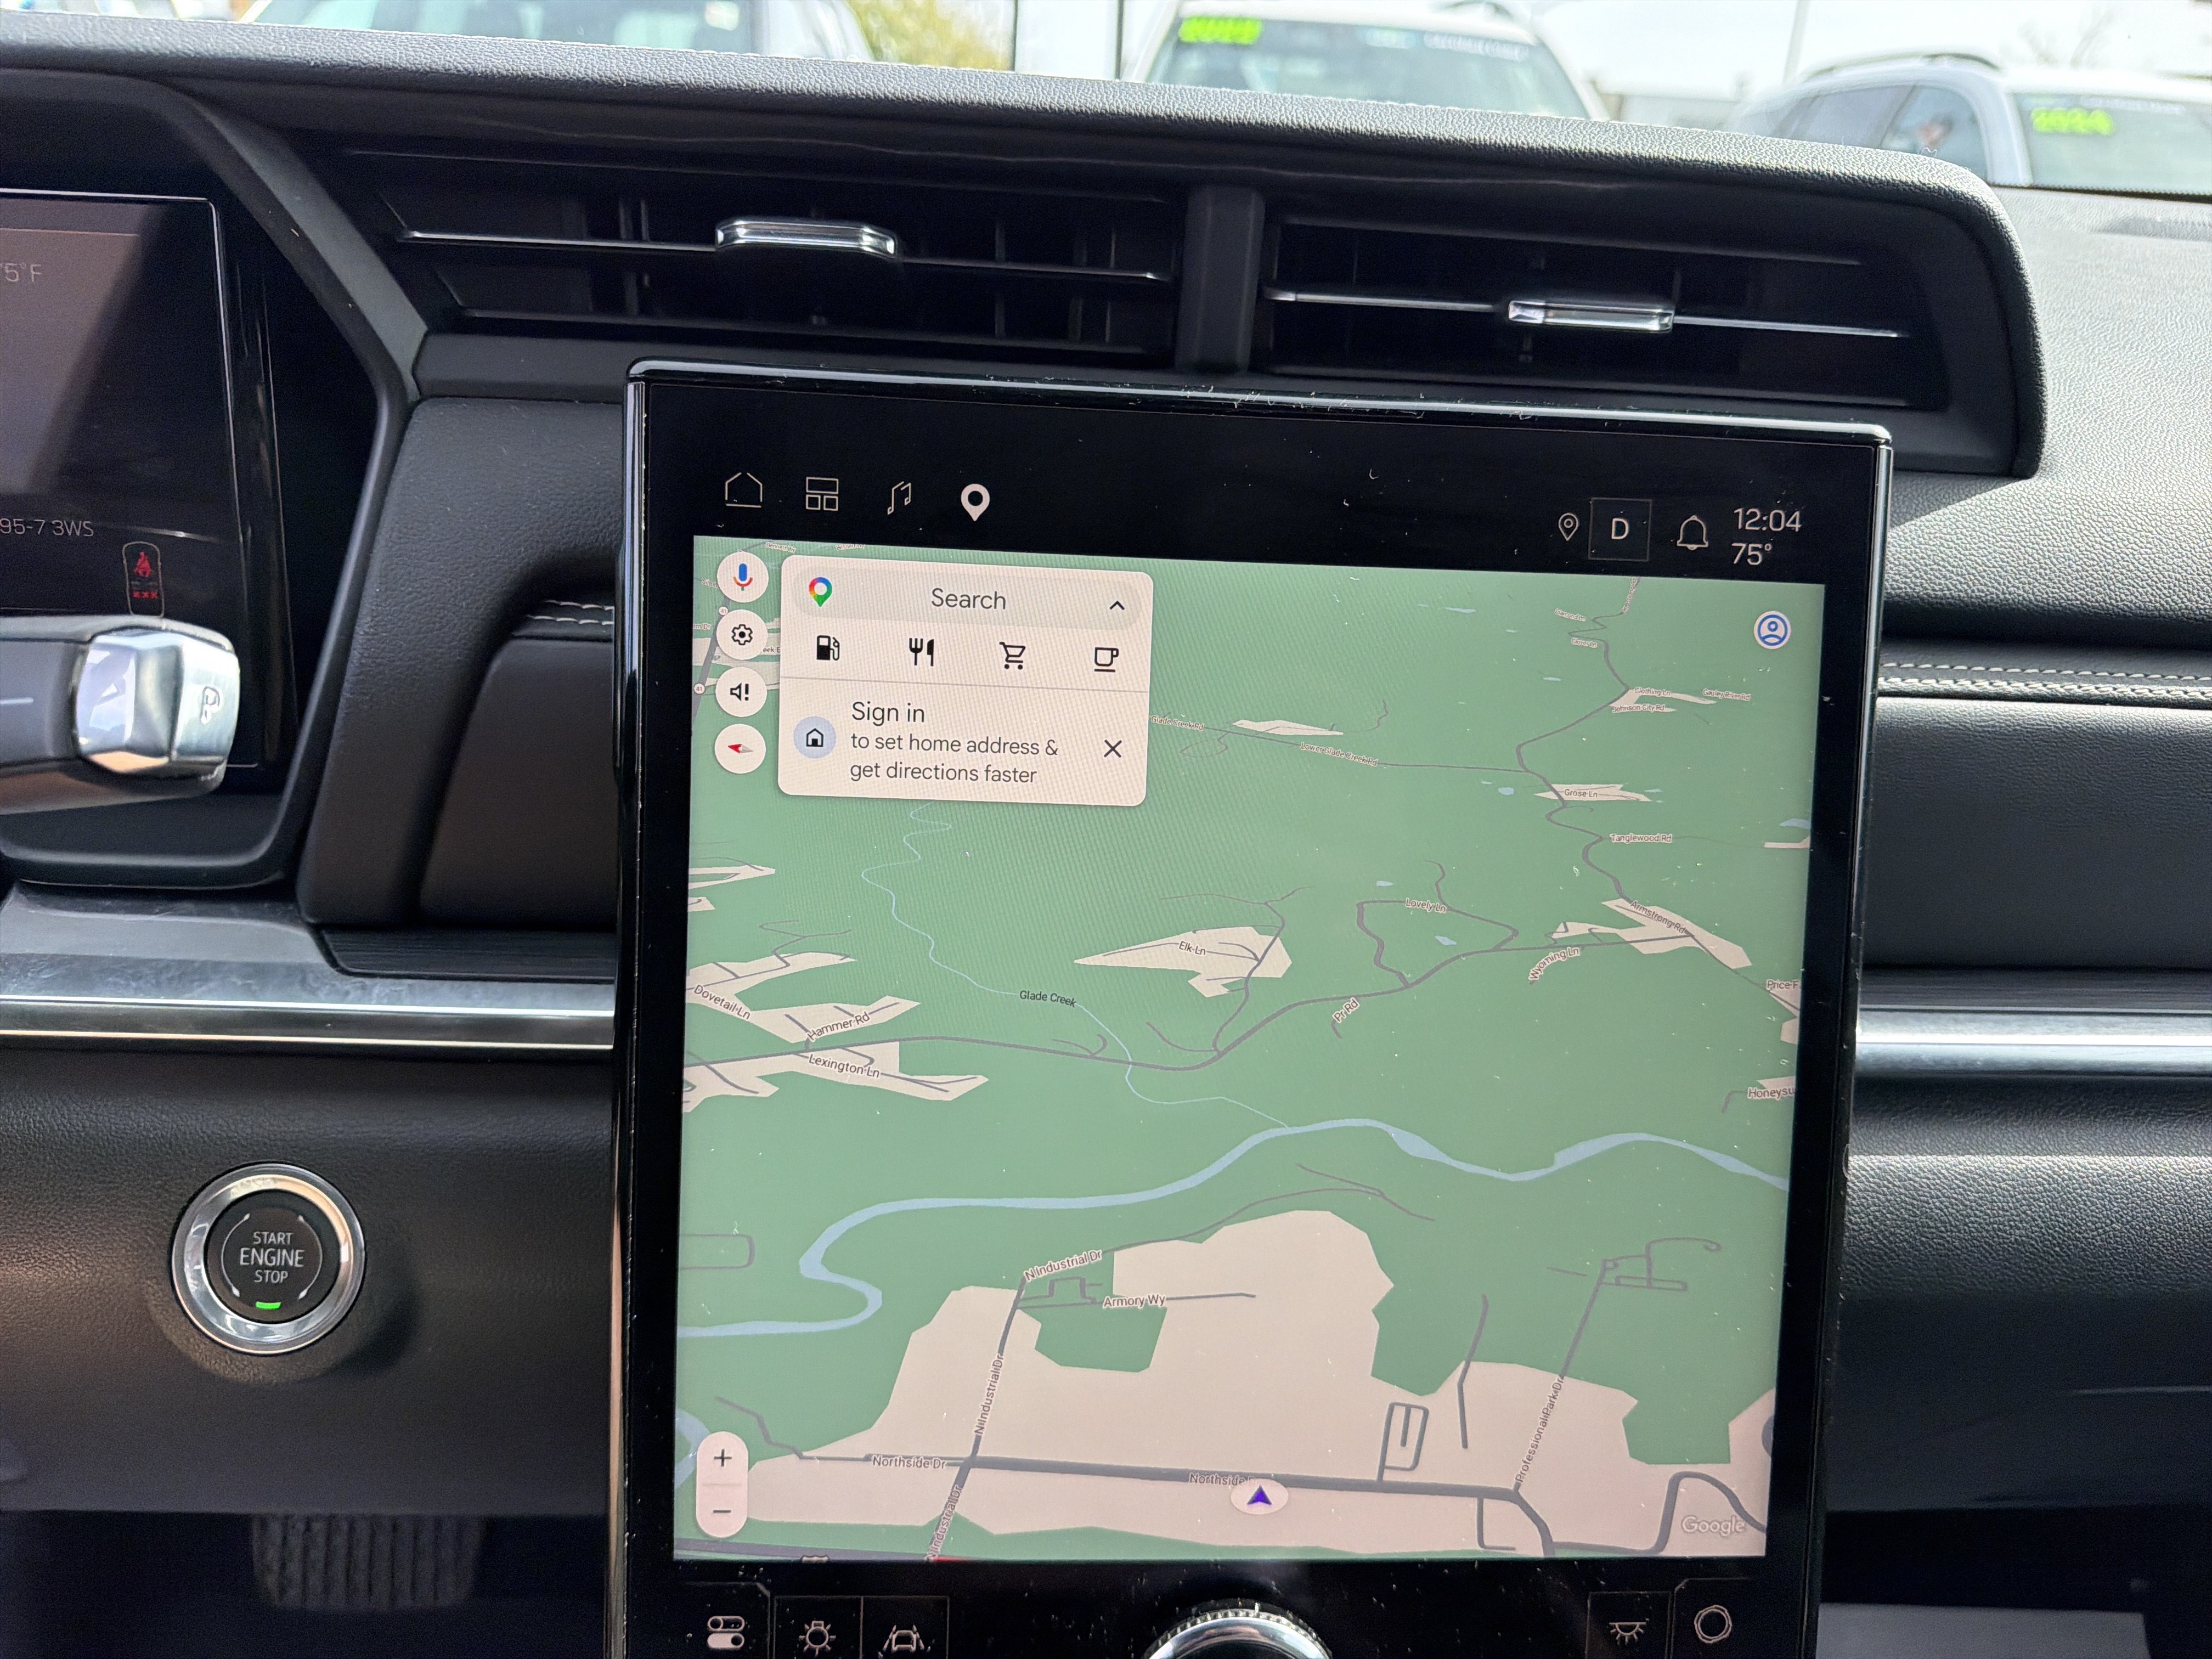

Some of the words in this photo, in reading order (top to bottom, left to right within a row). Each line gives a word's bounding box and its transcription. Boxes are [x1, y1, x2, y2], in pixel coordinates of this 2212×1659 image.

[52, 520, 94, 537] 3WS
[1611, 518, 1629, 539] D
[1734, 508, 1802, 532] 12:04
[1731, 543, 1772, 565] 75°
[932, 588, 1006, 610] Search
[1635, 687, 1661, 696] Clothing
[1703, 689, 1724, 699] Gauley
[200, 686, 221, 725] P
[852, 701, 899, 726] Sign
[907, 702, 924, 723] in
[1152, 715, 1172, 725] Glade
[1173, 719, 1193, 729] Creek
[851, 733, 869, 749] to
[875, 735, 903, 751] set
[909, 733, 961, 752] home
[967, 736, 1040, 755] address
[1045, 739, 1059, 755] &
[1301, 742, 1322, 753] Lower
[1324, 747, 1345, 758] Glade
[1346, 753, 1366, 764] Creek
[1368, 758, 1378, 766] Rd
[850, 763, 881, 781] get
[886, 761, 979, 781] directions
[984, 764, 1037, 783] faster
[1564, 788, 1586, 798] Grose
[1611, 834, 1658, 843] Tanglewood
[1406, 898, 1434, 911] Lovely
[1436, 903, 1446, 912] Ln
[1630, 900, 1674, 929] Armstrong
[1673, 923, 1684, 934] Rd
[1178, 940, 1193, 953] Elk
[1194, 945, 1206, 955] Ln
[1530, 950, 1566, 980] Wyoming
[1568, 947, 1579, 956] Ln
[1768, 980, 1791, 989] Price
[694, 985, 738, 1013] Dovetail
[738, 1006, 751, 1020] Ln
[1019, 990, 1048, 1001] Glade
[1050, 993, 1076, 1008] Creek
[1334, 1011, 1345, 1022] Pr
[1344, 998, 1358, 1013] Rd
[808, 1019, 853, 1040] Hammer
[855, 1011, 870, 1025] Rd
[809, 1053, 863, 1075] Lexington
[866, 1065, 879, 1078] Ln
[253, 1231, 294, 1245] START
[240, 1247, 305, 1267] ENGINE
[1025, 1271, 1036, 1281] N
[1036, 1253, 1087, 1277] Industrial
[1090, 1250, 1102, 1261] Dr
[254, 1269, 289, 1284] STOP
[1104, 1296, 1145, 1308] Armory
[1148, 1294, 1166, 1306] Wy
[992, 1355, 1004, 1368] Dr
[977, 1370, 1001, 1423] Industrial
[974, 1425, 985, 1435] N
[1515, 1416, 1548, 1482] Professional
[1542, 1395, 1559, 1416] Park
[1552, 1378, 1564, 1391] Dr
[873, 1455, 930, 1468] Northside
[933, 1458, 946, 1469] Dr
[1190, 1473, 1246, 1486] Northside
[930, 1500, 958, 1551] Industrial
[950, 1485, 962, 1499] Dr
[1681, 1515, 1746, 1537] Google
